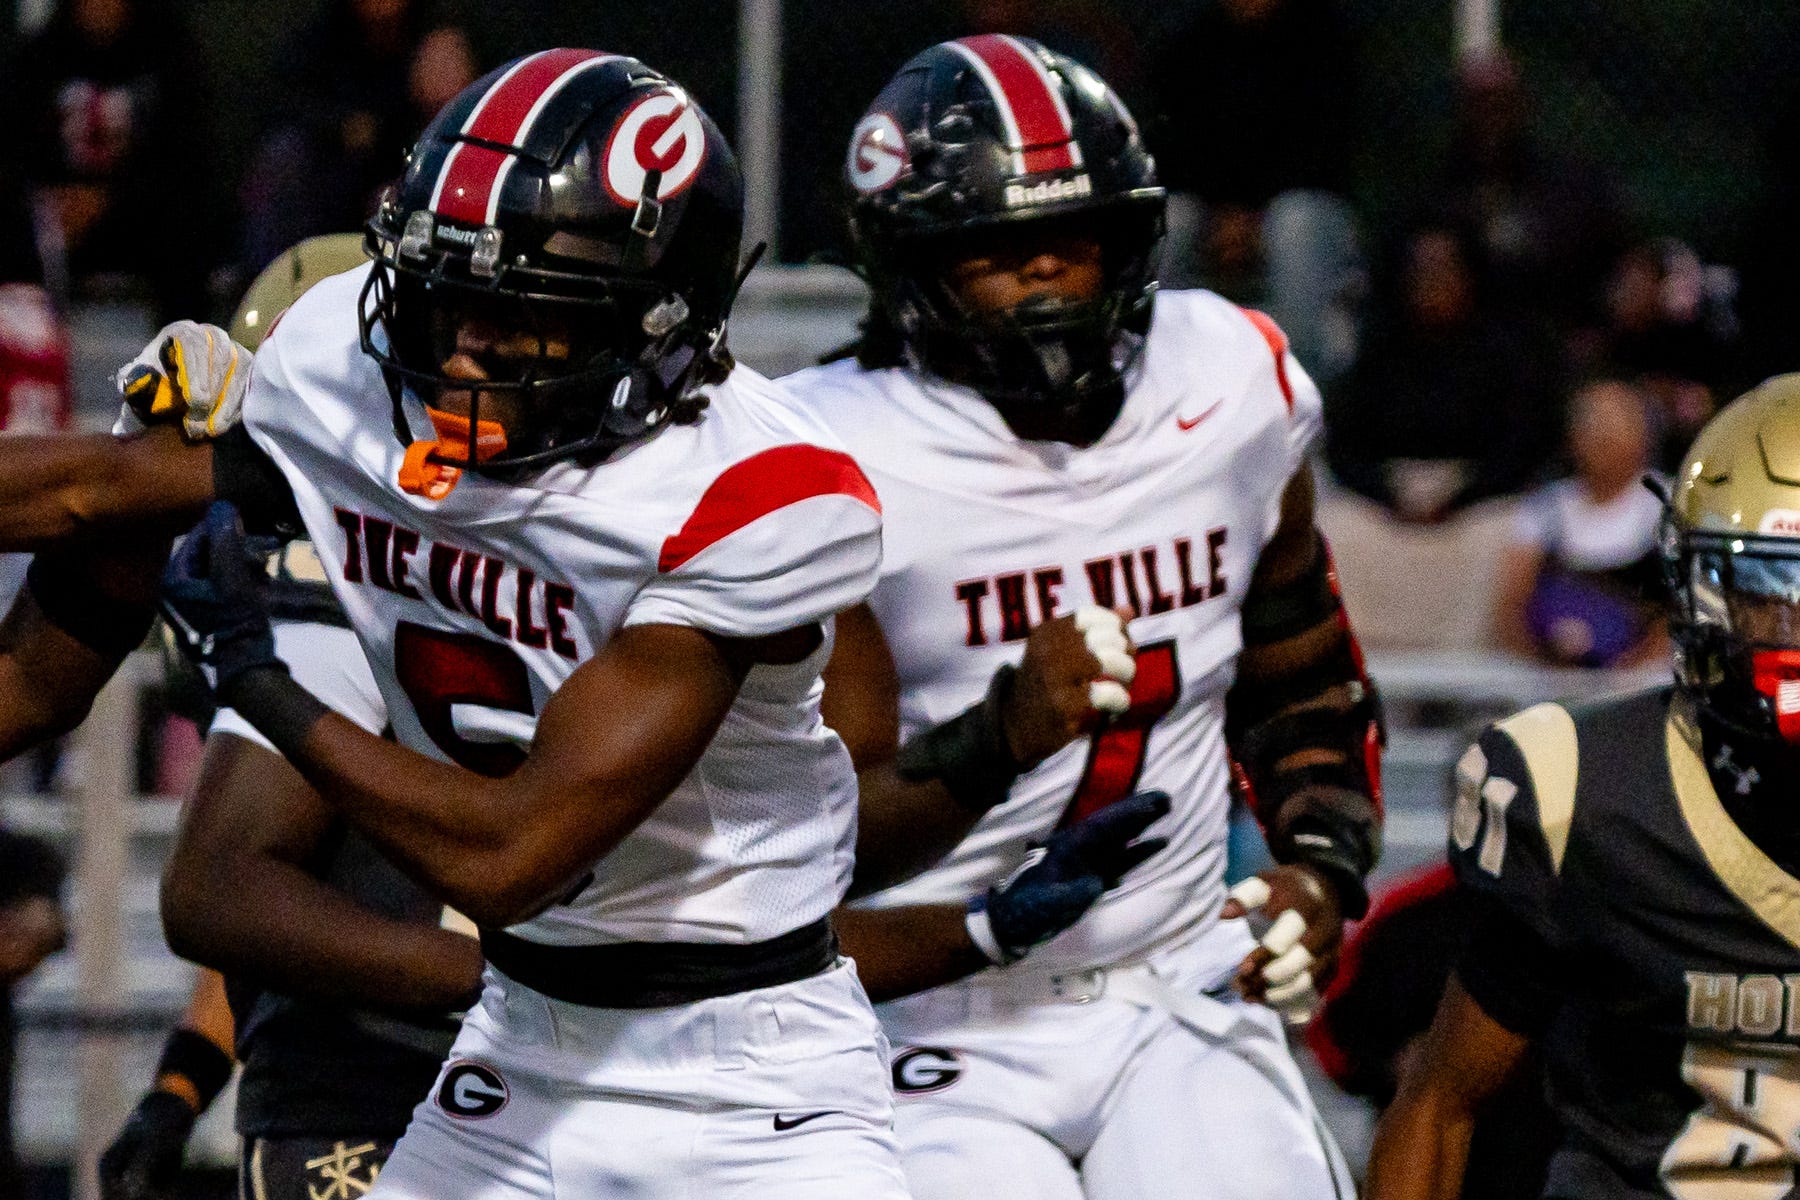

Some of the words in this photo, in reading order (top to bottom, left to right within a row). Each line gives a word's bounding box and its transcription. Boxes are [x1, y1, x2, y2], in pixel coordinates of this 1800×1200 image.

[603, 88, 708, 208] G
[1006, 174, 1092, 206] Riddell
[429, 542, 578, 660] VILLE
[955, 567, 1064, 646] THE
[1084, 526, 1228, 619] VILLE
[435, 1058, 510, 1120] G
[891, 1045, 964, 1095] G
